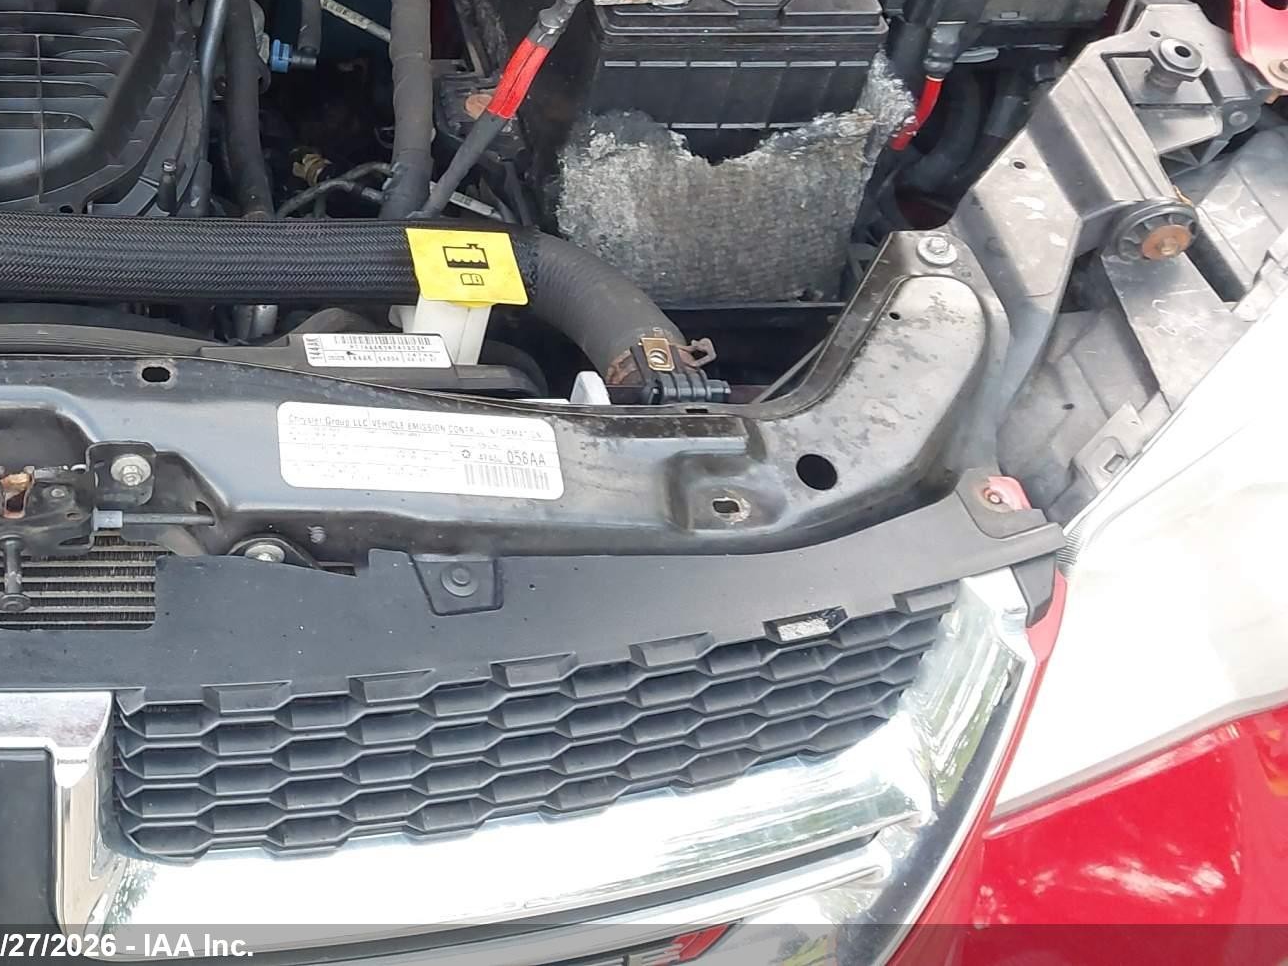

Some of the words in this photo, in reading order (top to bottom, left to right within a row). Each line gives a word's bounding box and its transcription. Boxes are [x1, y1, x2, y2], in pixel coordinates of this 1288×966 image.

[325, 416, 350, 427] Group
[353, 418, 369, 427] LLC
[371, 418, 404, 430] VEHICLE
[407, 422, 446, 433] EMISSION
[447, 425, 485, 436] CONTRL
